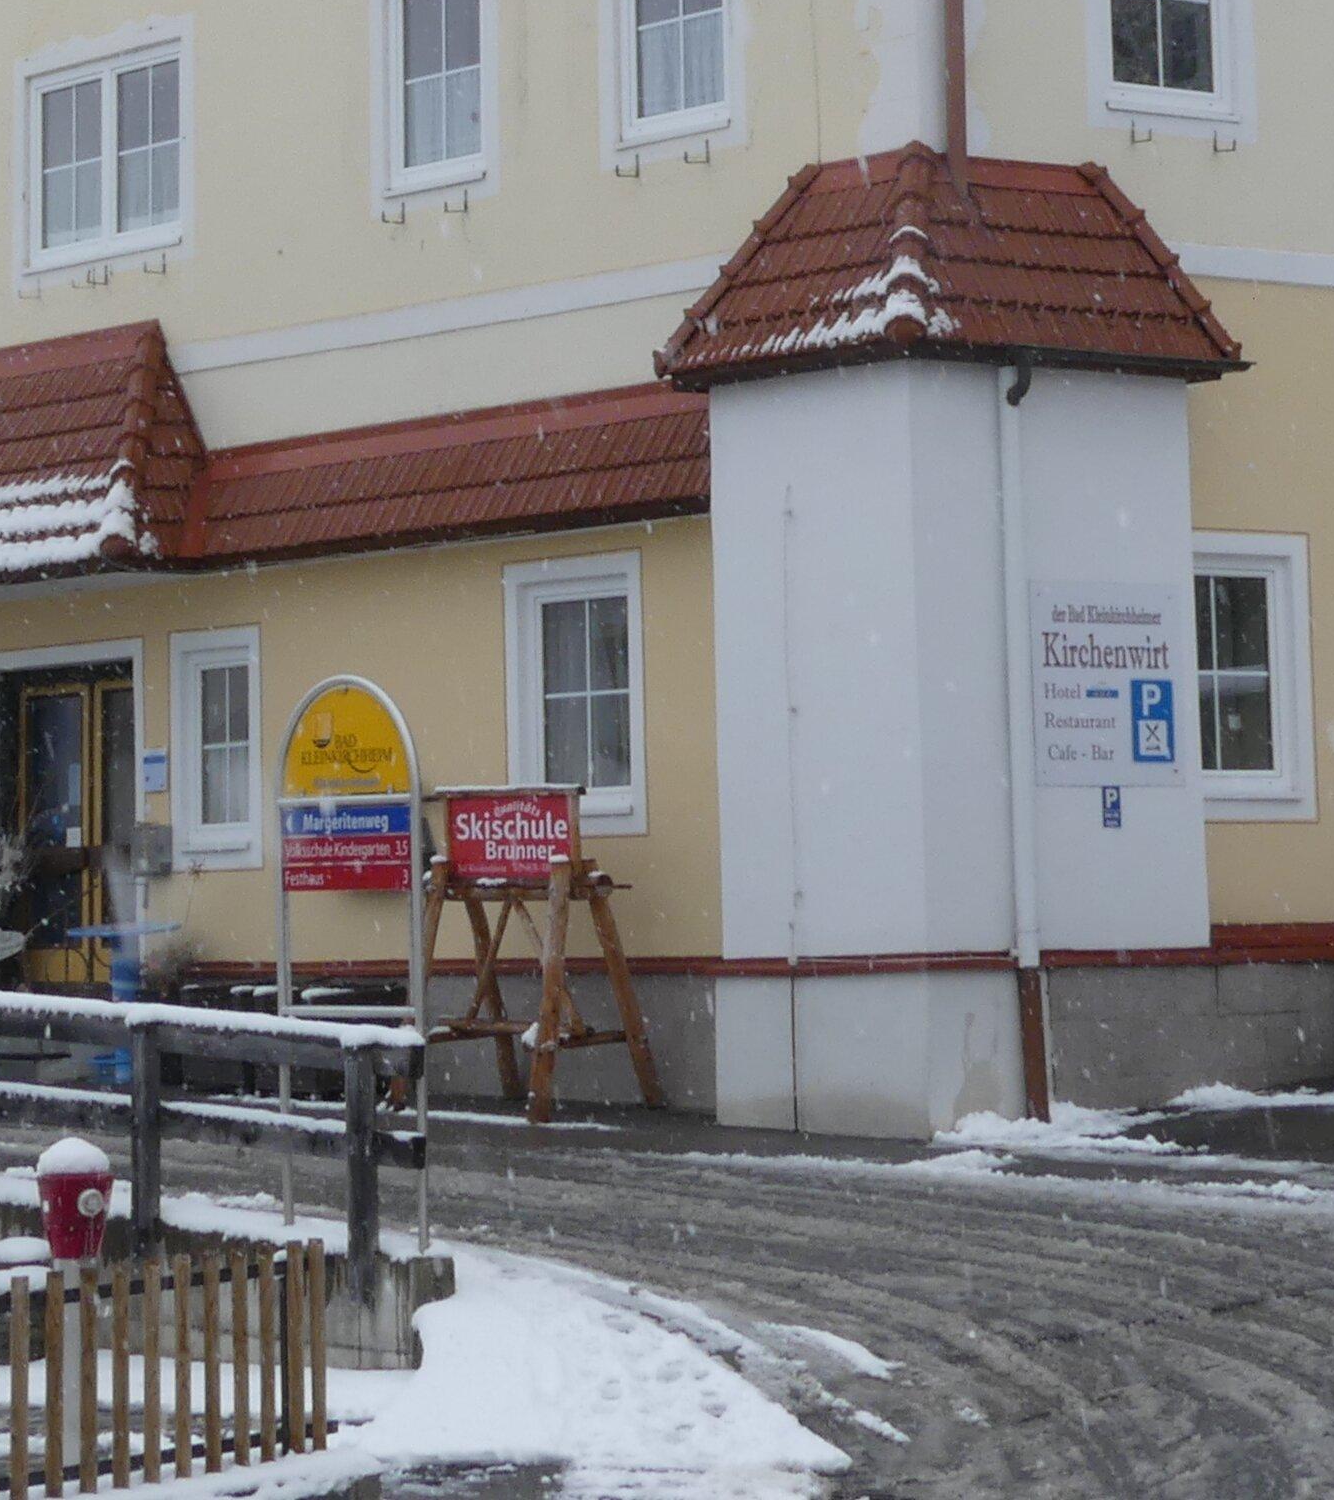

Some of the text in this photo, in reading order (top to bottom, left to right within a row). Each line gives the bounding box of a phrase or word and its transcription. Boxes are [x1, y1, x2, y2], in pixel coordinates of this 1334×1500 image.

[1052, 603, 1162, 625] der Bad Kleinkirchheimer
[1041, 631, 1170, 670] Kirchenwirt
[1043, 682, 1082, 700] Hotel
[1141, 683, 1161, 717] P
[1043, 711, 1117, 730] Restaurant
[335, 734, 358, 748] BAD
[1091, 744, 1116, 761] Bar
[1105, 788, 1118, 809] P
[302, 812, 389, 835] Margeritenweg
[455, 810, 568, 840] Skischule
[485, 840, 556, 860] Brunner
[284, 869, 409, 886] Festhaus 3
